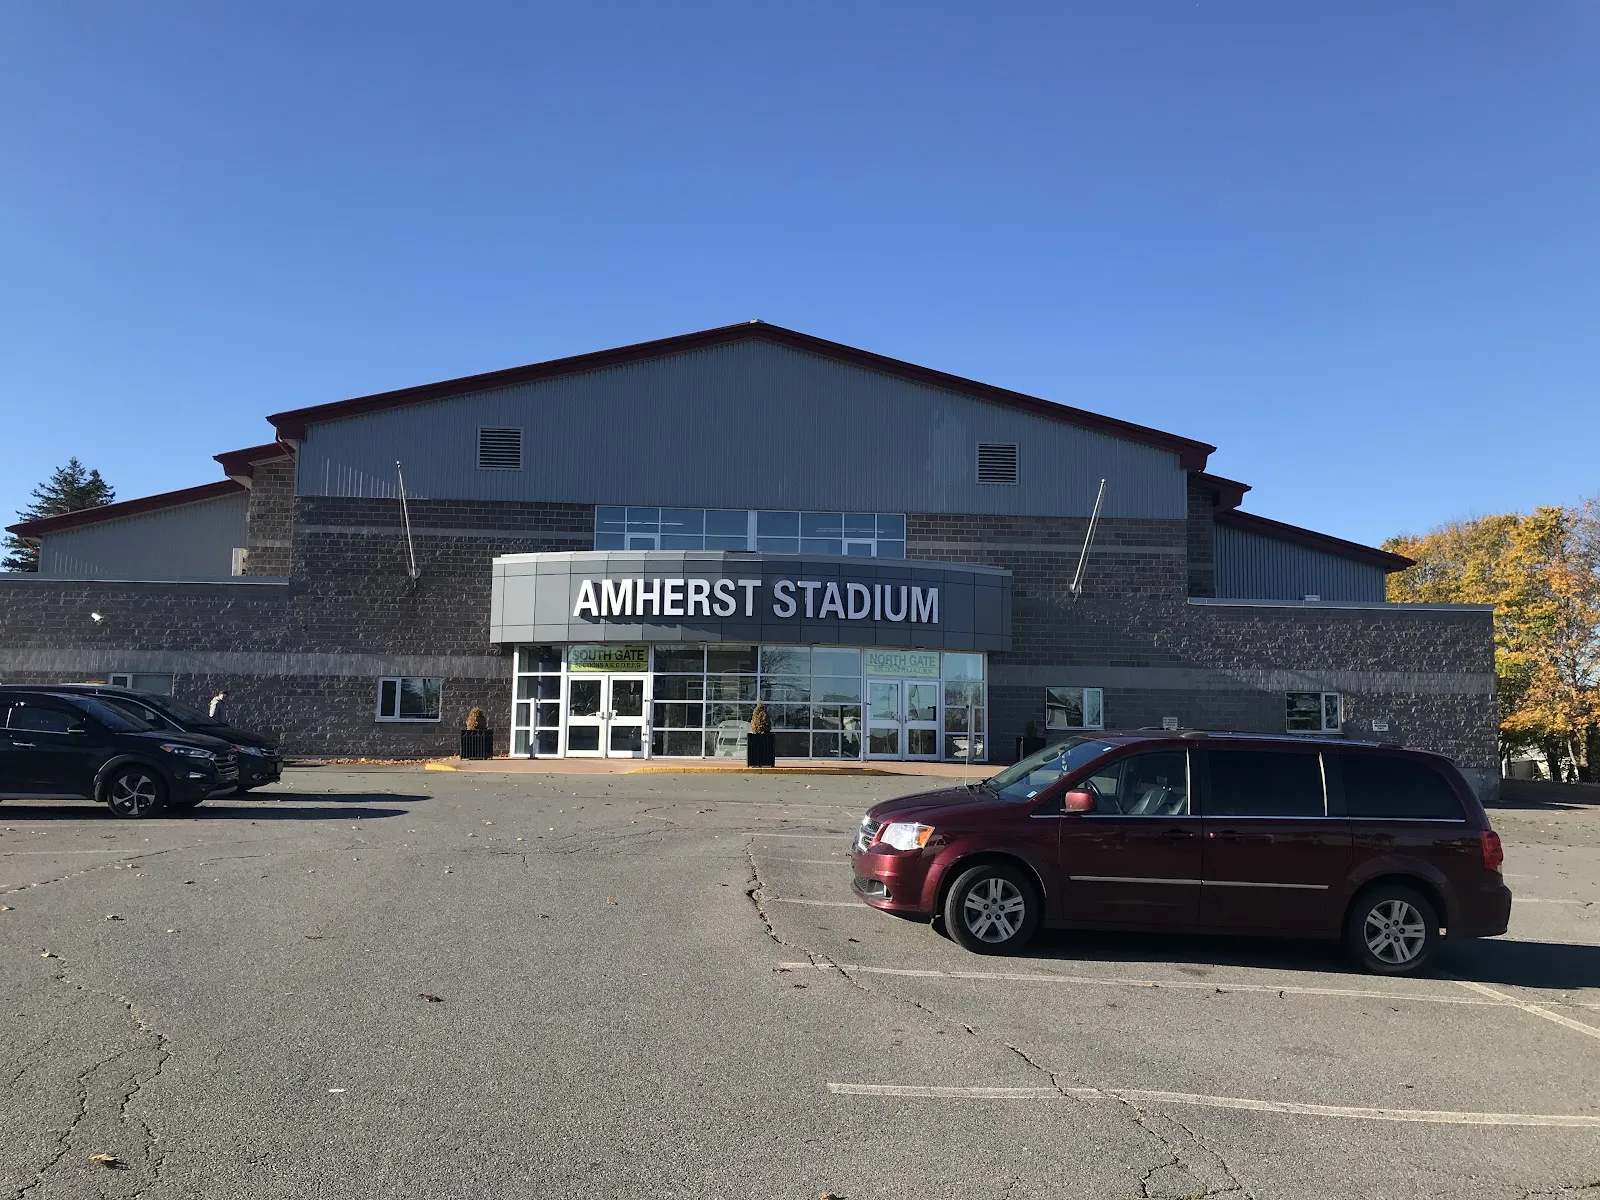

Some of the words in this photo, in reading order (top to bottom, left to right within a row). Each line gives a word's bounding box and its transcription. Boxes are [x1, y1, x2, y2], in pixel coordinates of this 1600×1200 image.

[573, 579, 762, 617] AMHERST
[773, 580, 939, 624] STADIUM
[573, 649, 612, 661] SOUTH
[615, 649, 645, 661] GATE
[870, 653, 906, 665] NORTH
[910, 655, 936, 667] GATE
